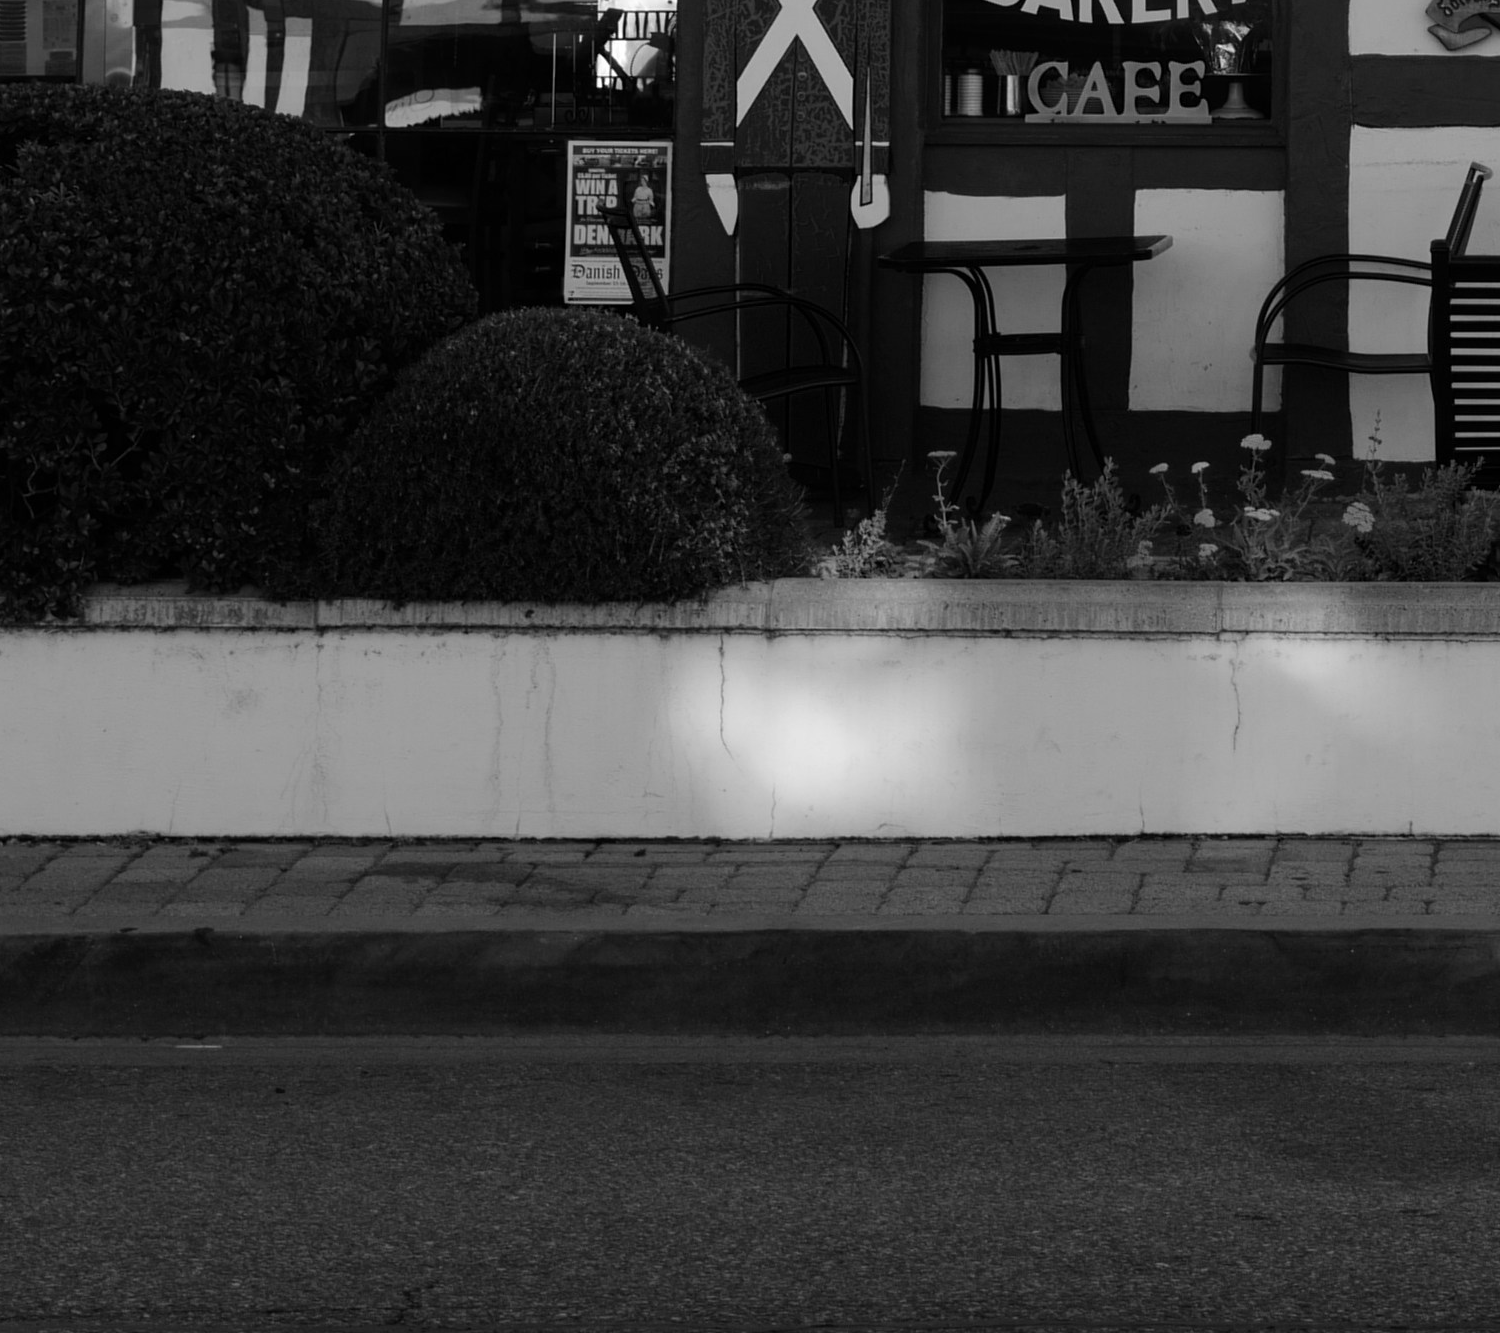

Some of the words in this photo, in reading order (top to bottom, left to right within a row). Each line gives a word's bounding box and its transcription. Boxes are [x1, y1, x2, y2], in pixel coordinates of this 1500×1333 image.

[1027, 60, 1210, 116] CAFE
[575, 179, 605, 195] WIN
[608, 179, 619, 195] A
[575, 195, 618, 215] TRP
[571, 263, 620, 280] Danish
